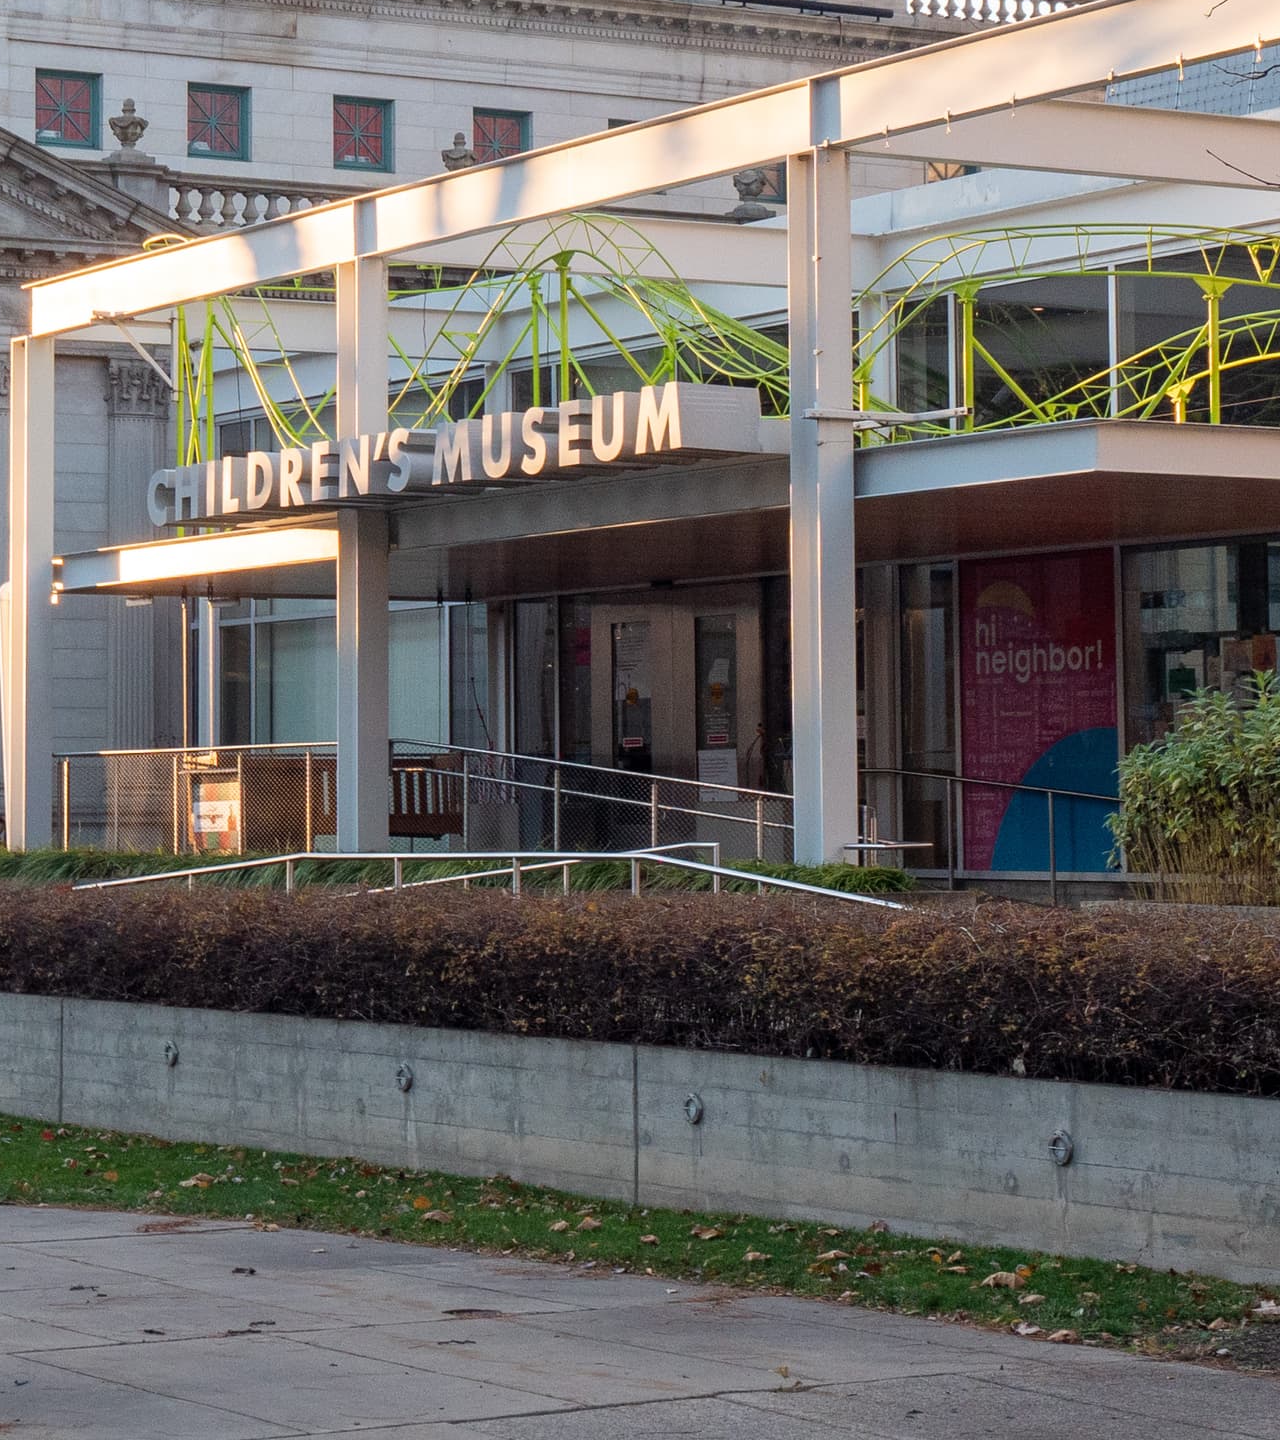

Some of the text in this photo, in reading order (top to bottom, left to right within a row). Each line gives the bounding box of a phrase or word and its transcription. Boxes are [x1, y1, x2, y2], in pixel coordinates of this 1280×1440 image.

[146, 381, 682, 527] CHILDREN'S MUSEUM
[976, 613, 997, 647] hi
[976, 639, 1104, 683] neighbor!
